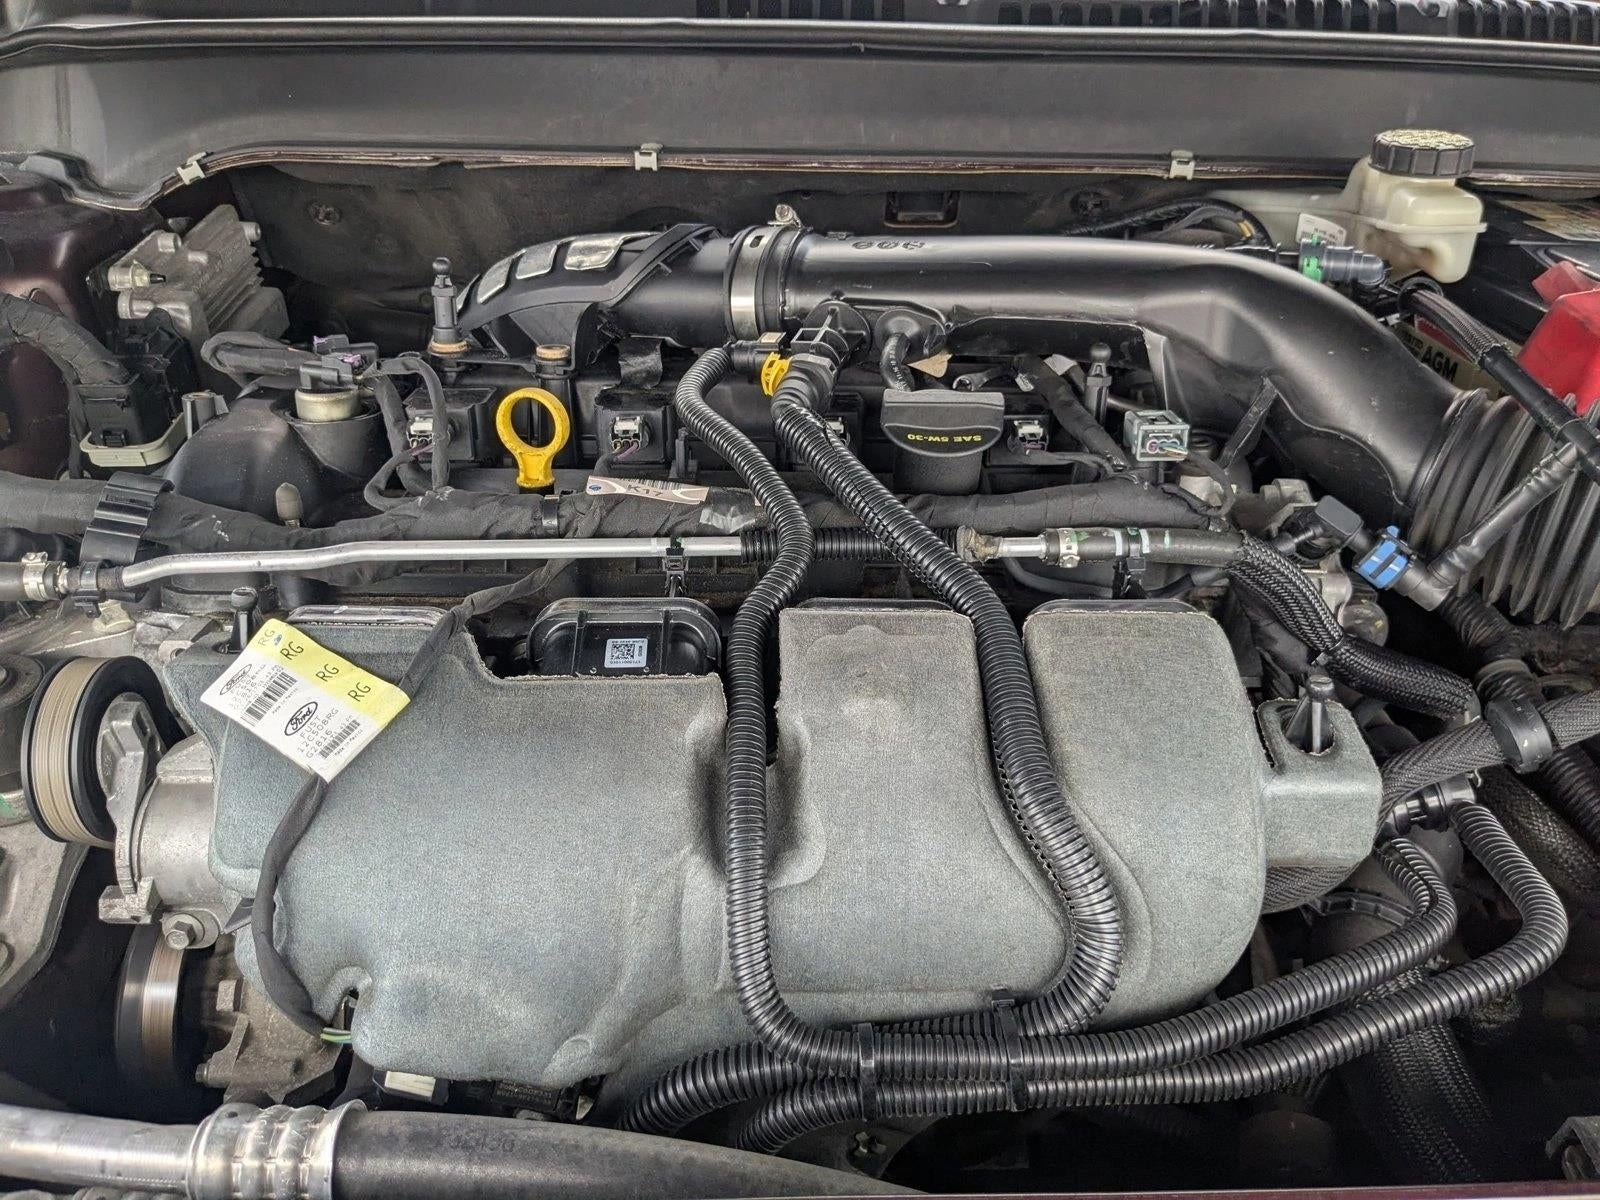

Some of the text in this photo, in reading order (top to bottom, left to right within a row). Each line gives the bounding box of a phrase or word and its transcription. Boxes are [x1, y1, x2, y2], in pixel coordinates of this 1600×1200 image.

[1421, 346, 1458, 383] AGM
[907, 433, 982, 443] SAE 5W-30
[627, 484, 664, 497] K17
[258, 629, 276, 647] RG
[280, 641, 304, 661] RG
[316, 664, 339, 682] RG
[347, 682, 371, 702] RG
[289, 706, 313, 731] Ford
